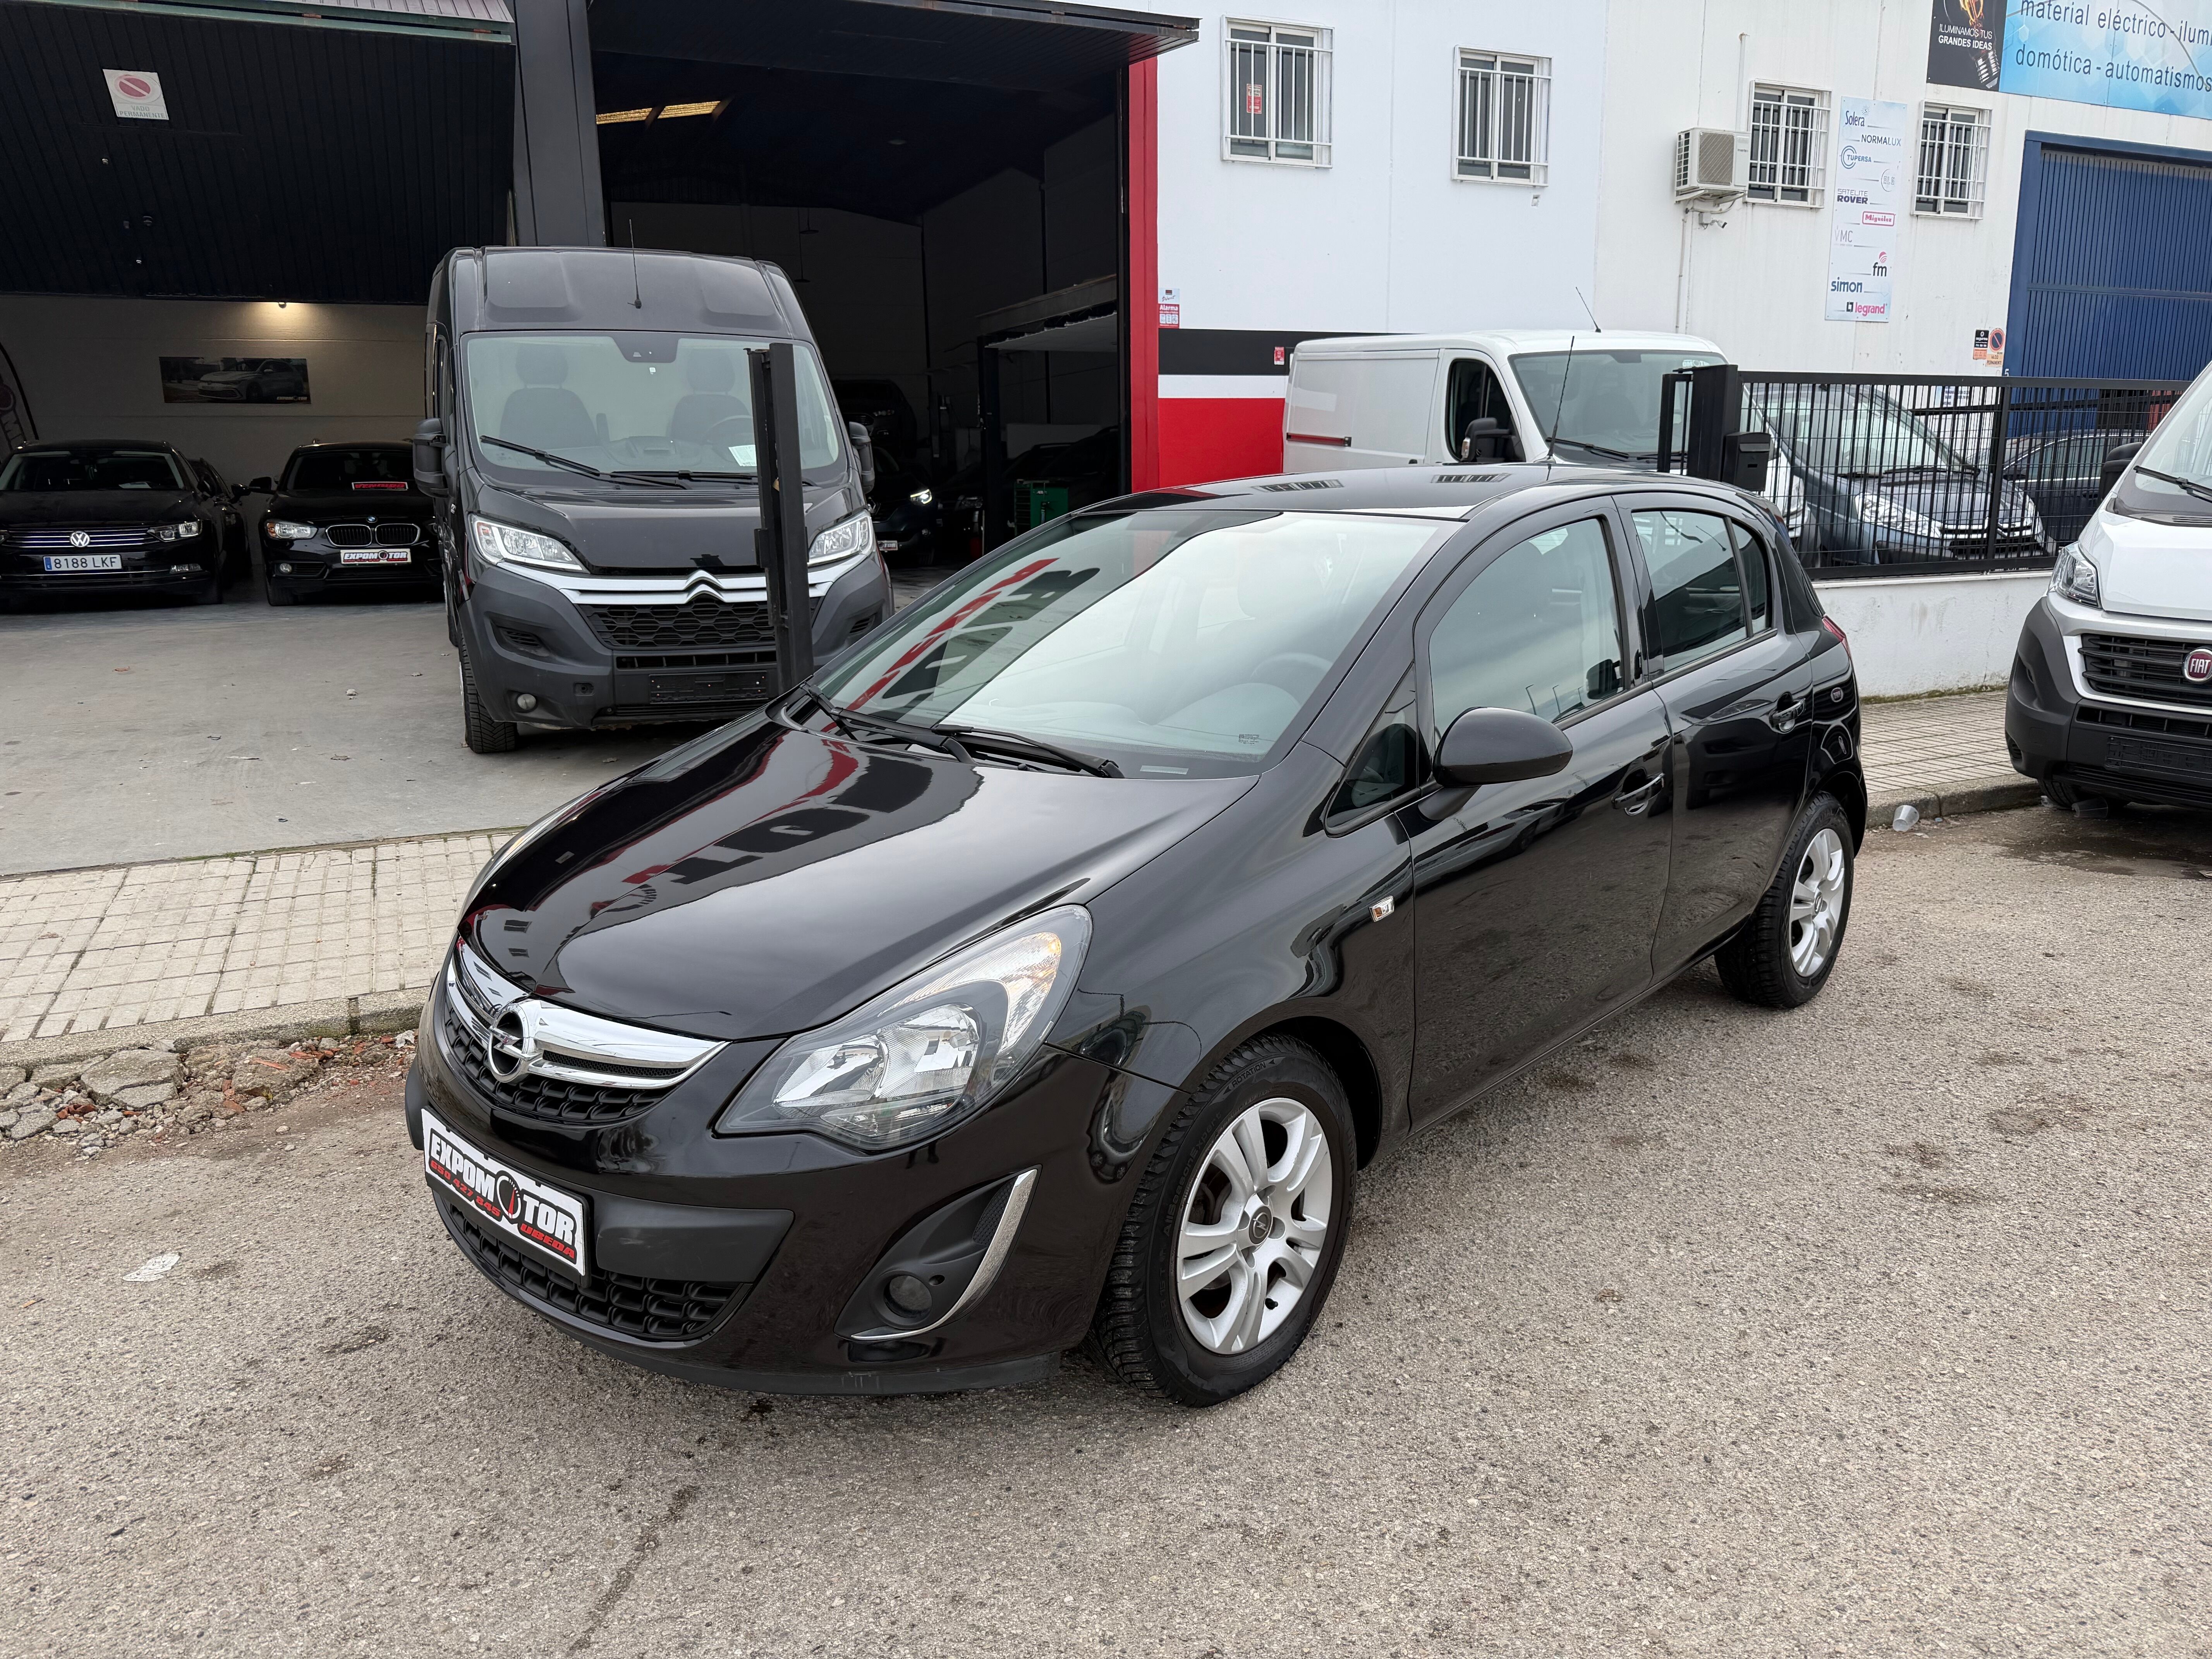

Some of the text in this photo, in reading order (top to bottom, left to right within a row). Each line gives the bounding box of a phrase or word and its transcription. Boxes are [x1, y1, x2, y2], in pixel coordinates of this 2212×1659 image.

[2021, 0, 2089, 25] material
[2097, 8, 2166, 38] eléctrico
[1939, 24, 1992, 39] ILUMINAMOS TUS
[1939, 35, 1992, 50] GRANDES IDEAS
[2016, 44, 2091, 75] domótica
[2105, 60, 2212, 92] automatismos
[1845, 110, 1865, 127] Solera
[1861, 134, 1901, 146] NORMALUX
[1837, 195, 1868, 204] ROVER
[1838, 189, 1868, 197] SATELITE
[1873, 262, 1887, 277] fm
[1831, 276, 1863, 293] simon
[1855, 302, 1885, 317] legrand
[54, 556, 117, 569] 8188 LKF
[2190, 658, 2211, 674] FIAT
[430, 1160, 501, 1218] 650 427 845
[520, 1223, 575, 1259] UBEDA
